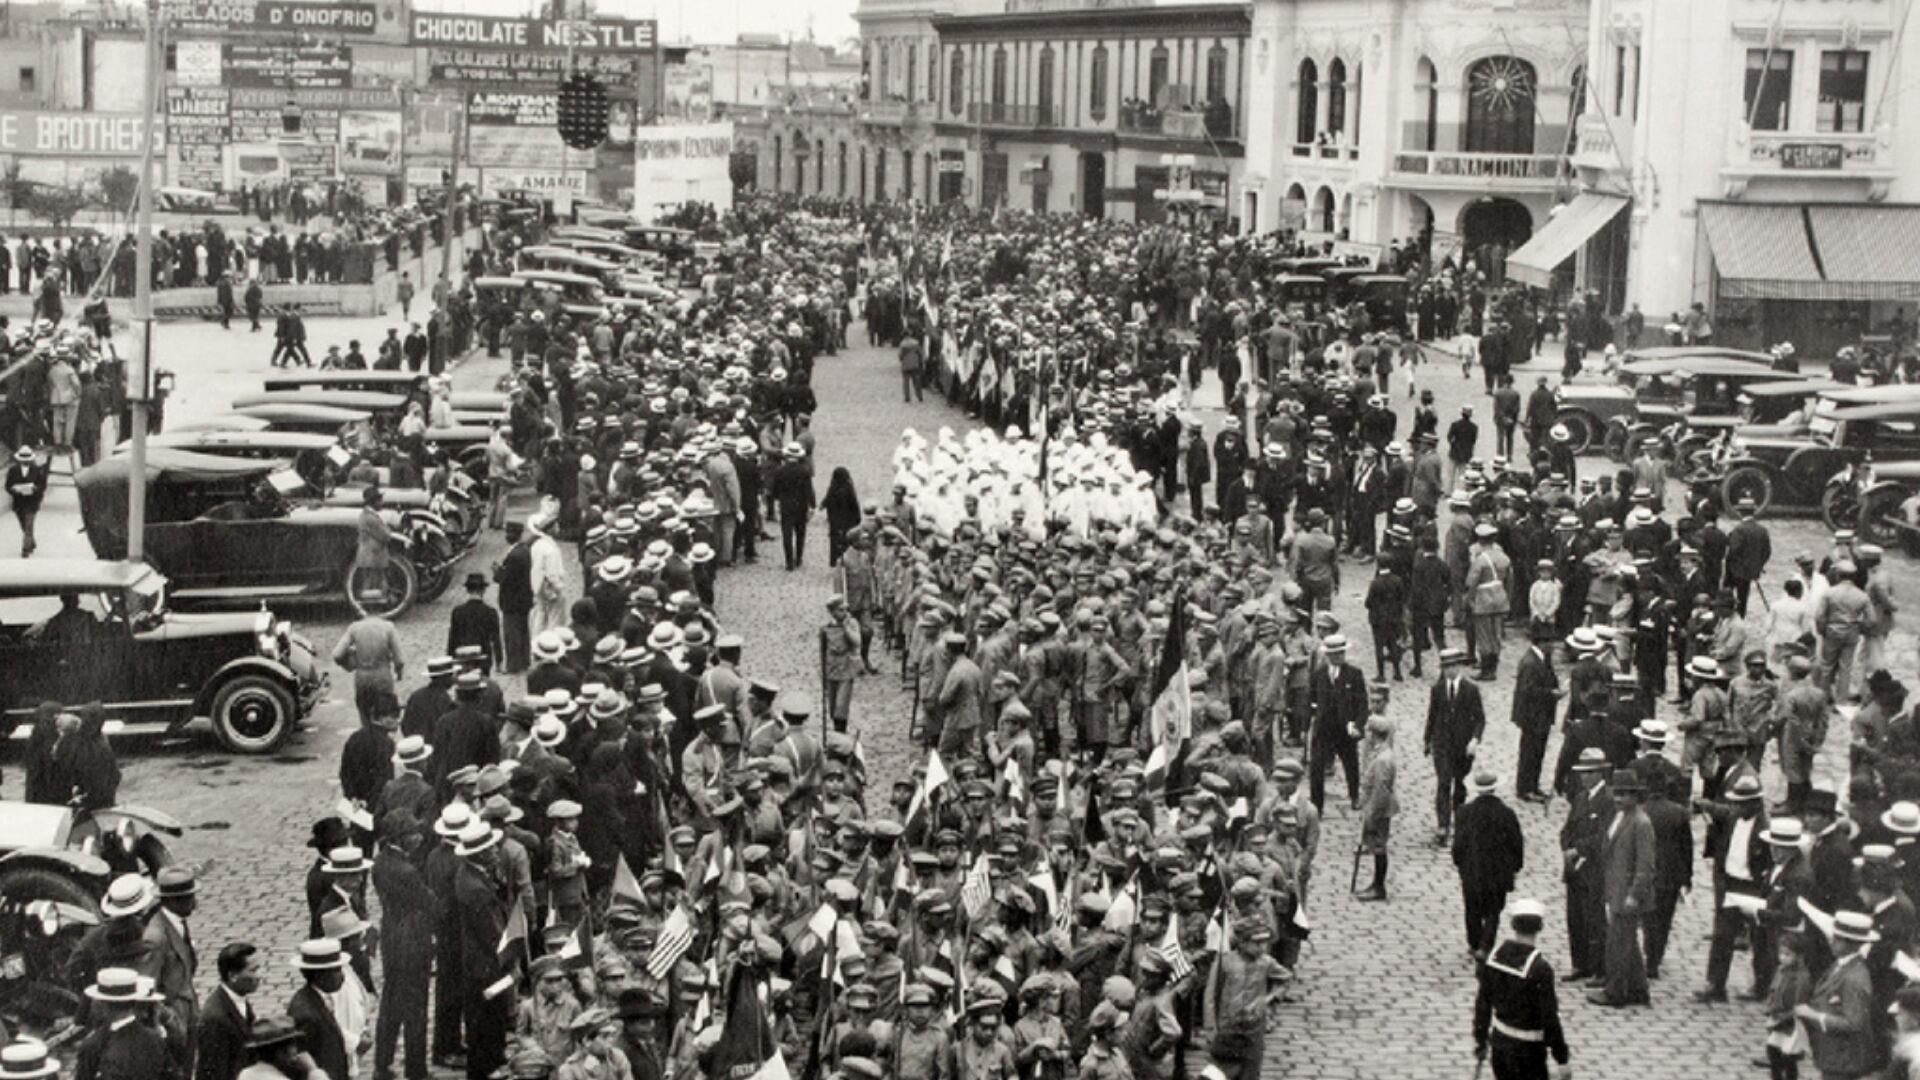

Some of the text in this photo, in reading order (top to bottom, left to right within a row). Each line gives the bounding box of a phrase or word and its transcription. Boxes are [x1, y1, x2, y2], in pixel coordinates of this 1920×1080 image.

[415, 18, 654, 47] CHOCOLATE NESTLÉ
[2, 115, 18, 148] E
